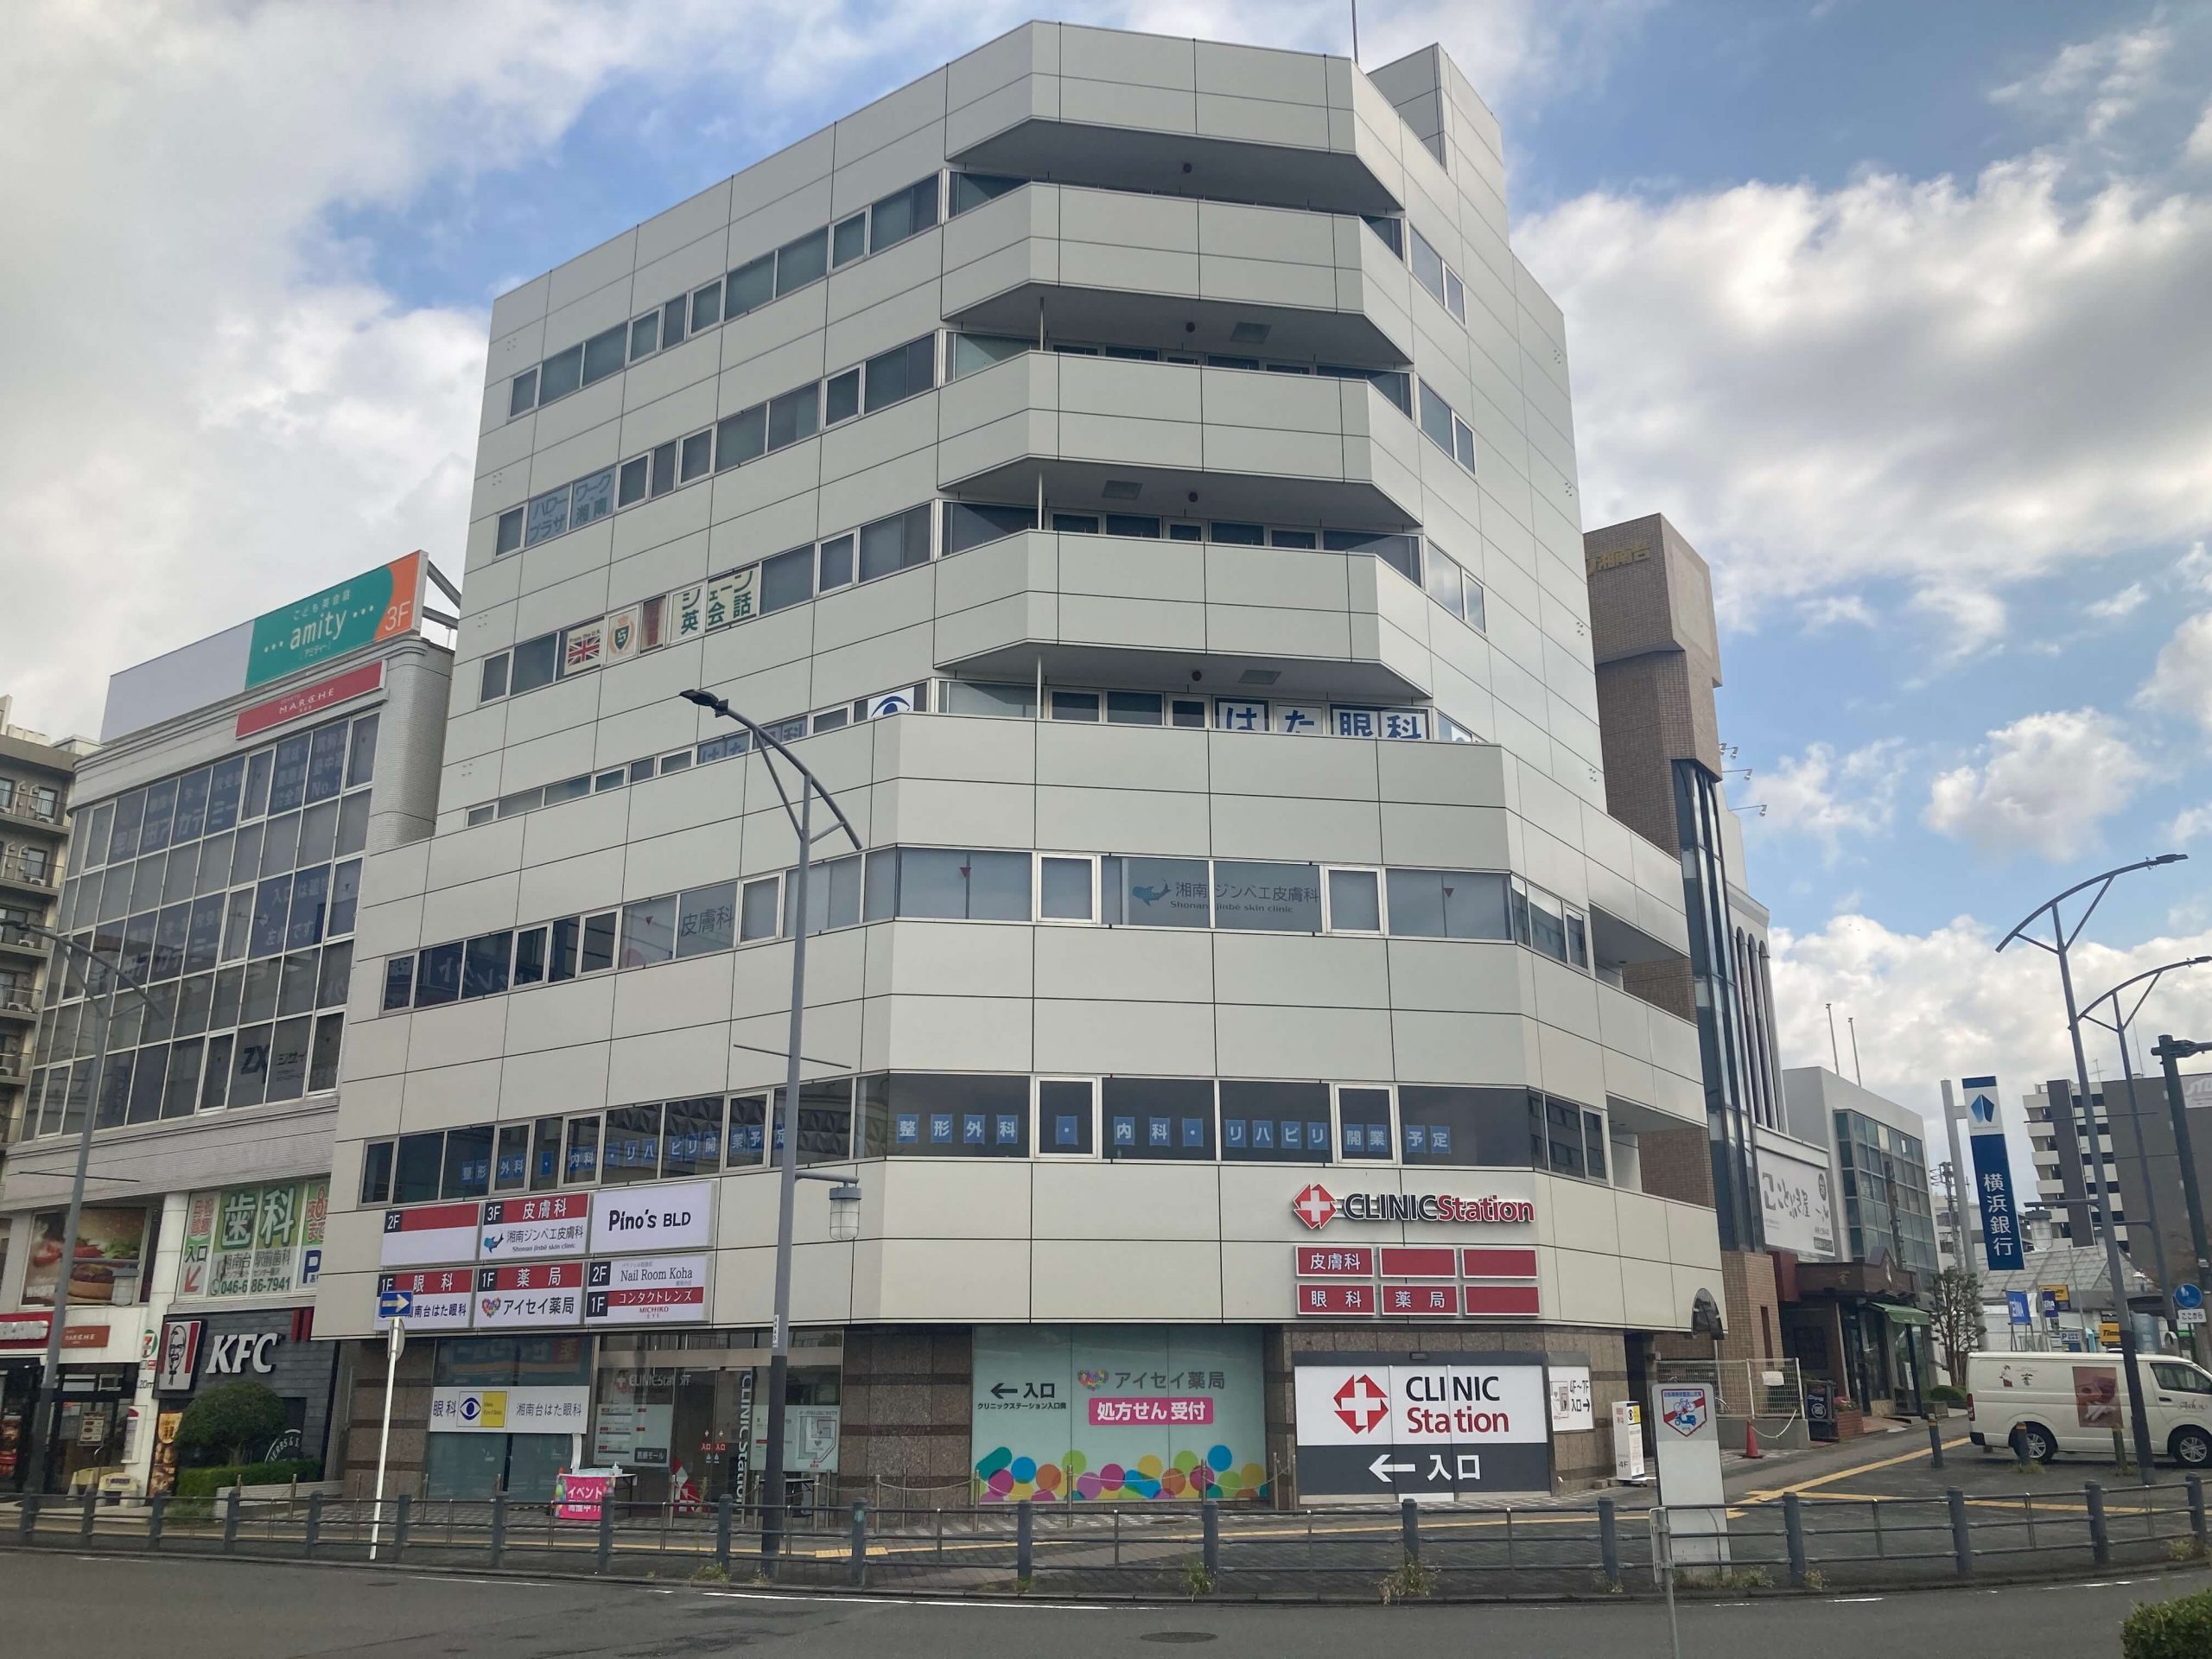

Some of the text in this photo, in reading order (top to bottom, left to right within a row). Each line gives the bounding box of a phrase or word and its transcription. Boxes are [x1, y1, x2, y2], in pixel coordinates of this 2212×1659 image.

[683, 570, 753, 610] シェーン
[385, 601, 411, 632] 3F
[681, 591, 752, 635] 英会話
[290, 610, 347, 650] amity
[279, 688, 334, 715] MARCHE
[1225, 706, 1423, 739] はた眼科
[1175, 881, 1319, 904] 湘南ジンベエ皮膚科
[1170, 900, 1209, 909] Shonan
[1243, 903, 1265, 912] skin
[1268, 905, 1294, 913] clinic
[681, 904, 735, 937] 皮膚科
[221, 1186, 296, 1249] 歯科
[487, 1205, 501, 1221] 3F
[523, 1198, 567, 1220] 皮膚科
[1984, 1173, 2014, 1256] 横浜銀行
[387, 1214, 400, 1230] 2F
[608, 1210, 691, 1231] Pino's BLD
[506, 1224, 584, 1243] 湘南ジンベエ皮膚科
[185, 1245, 208, 1263] 入口
[1310, 1253, 1361, 1271] 皮膚科
[302, 1249, 322, 1284] P
[592, 1266, 607, 1282] 2F
[620, 1267, 693, 1282] Nail Room Koha
[220, 1276, 291, 1294] 046-686-7941
[382, 1278, 394, 1292] 1F
[413, 1272, 453, 1293] 眼科
[482, 1272, 494, 1287] 1F
[517, 1266, 562, 1287] 薬局
[503, 1296, 575, 1315] アイセイ薬局
[591, 1296, 605, 1313] 1F
[619, 1290, 692, 1305] コンタクトレンズ
[1311, 1290, 1362, 1308] 眼科
[1395, 1290, 1446, 1309] 薬局
[205, 1332, 278, 1374] KFC
[628, 1373, 690, 1387] CLINICStaon
[1115, 1370, 1225, 1390] アイセイ薬局
[1406, 1376, 1500, 1402] CLINIC
[1023, 1382, 1055, 1398] 入口
[433, 1400, 457, 1418] 眼科
[516, 1402, 582, 1418] 湘南台はた眼科
[1571, 1398, 1582, 1412] 入口
[1408, 1405, 1510, 1433] Station
[1427, 1454, 1481, 1480] 入口
[568, 1486, 603, 1499] イベント
